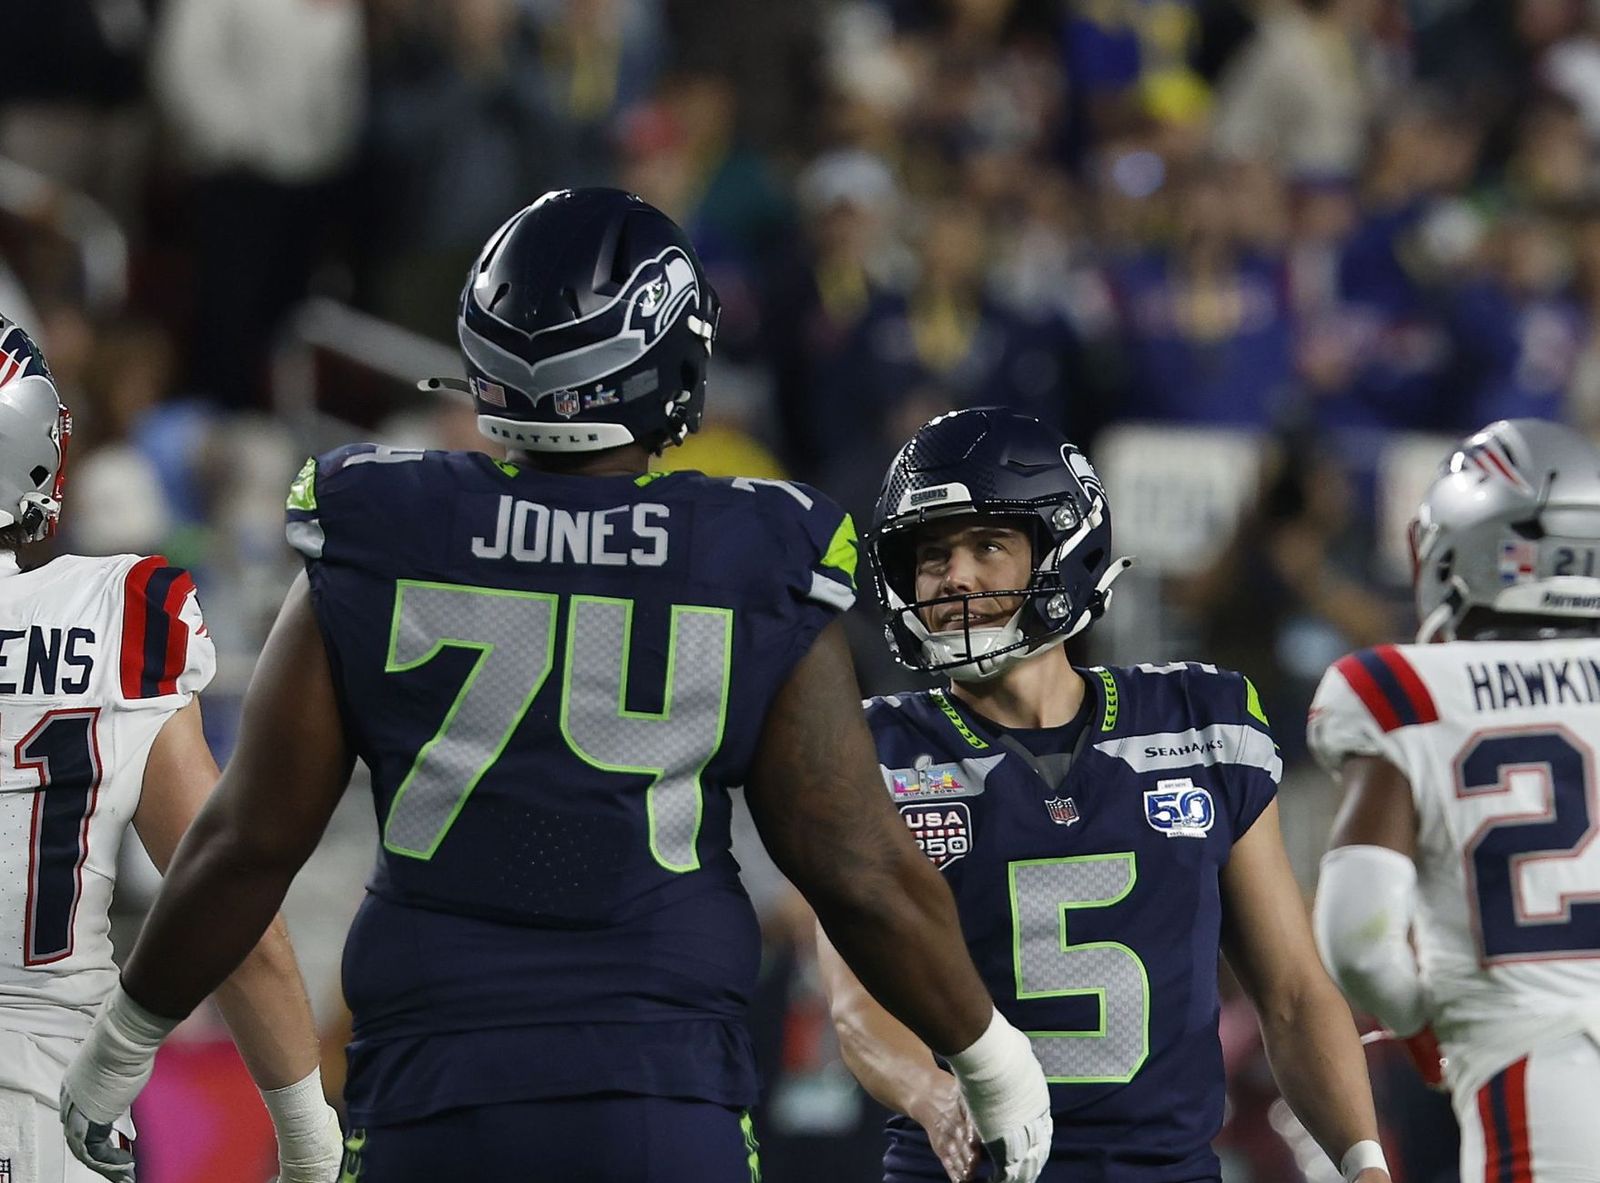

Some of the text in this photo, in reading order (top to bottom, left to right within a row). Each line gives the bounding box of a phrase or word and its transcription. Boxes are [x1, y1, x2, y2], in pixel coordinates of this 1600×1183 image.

[491, 426, 599, 443] SEATTLE
[471, 495, 669, 567] JONES
[1553, 546, 1596, 576] 21
[384, 578, 734, 873] 74
[905, 811, 963, 828] USA
[1147, 792, 1212, 829] 50
[1453, 722, 1600, 969] 2
[1008, 851, 1149, 1083] 5
